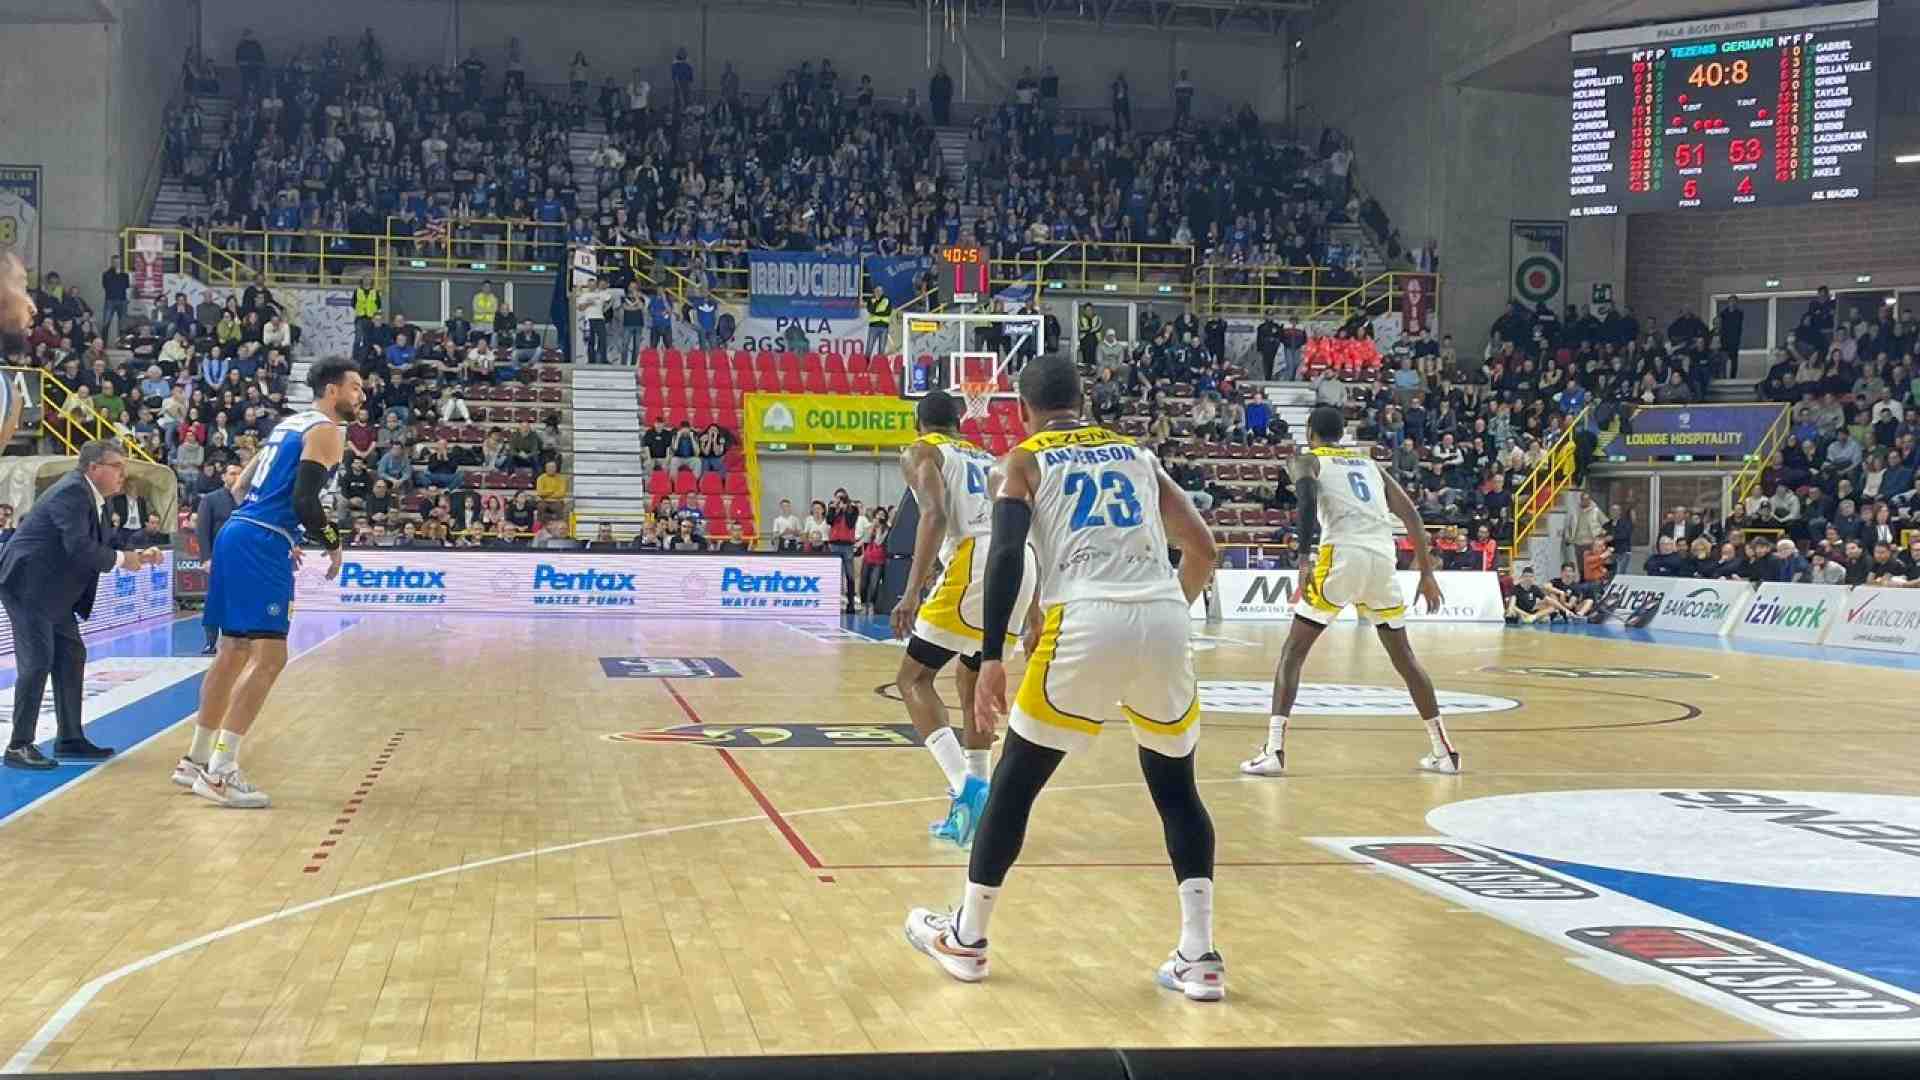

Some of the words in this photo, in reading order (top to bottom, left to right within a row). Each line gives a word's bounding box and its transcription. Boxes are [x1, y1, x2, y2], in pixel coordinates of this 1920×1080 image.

[1722, 38, 1774, 53] GERMANI
[1805, 33, 1814, 43] P
[1688, 60, 1748, 87] 40:8
[1815, 64, 1842, 75] DELLA
[1844, 61, 1873, 72] VALLE
[1815, 87, 1848, 97] TAYLOR
[1675, 143, 1703, 168] 51
[1729, 138, 1762, 163] 53
[1683, 179, 1697, 199] 5
[1737, 175, 1752, 193] 4
[943, 248, 978, 263] 40:5
[751, 261, 860, 296] IRRIDUCIBILI
[776, 316, 832, 334] PALA
[806, 409, 914, 430] COLDIRET
[1626, 432, 1668, 446] LOUNGE
[1670, 431, 1743, 446] HOSPITALITY
[1347, 472, 1370, 502] 6
[1063, 470, 1143, 532] 23
[340, 562, 446, 589] Pentax
[533, 564, 637, 591] Pentax
[721, 567, 820, 593] Pentax
[341, 593, 389, 603] WATER
[396, 593, 446, 603] PUMPS
[534, 596, 580, 605] WATER
[588, 596, 635, 605] PUMPS
[721, 598, 768, 607] WATER
[774, 599, 820, 608] PUMPS
[1662, 599, 1701, 618] BANCO
[1745, 595, 1826, 628] iziwork
